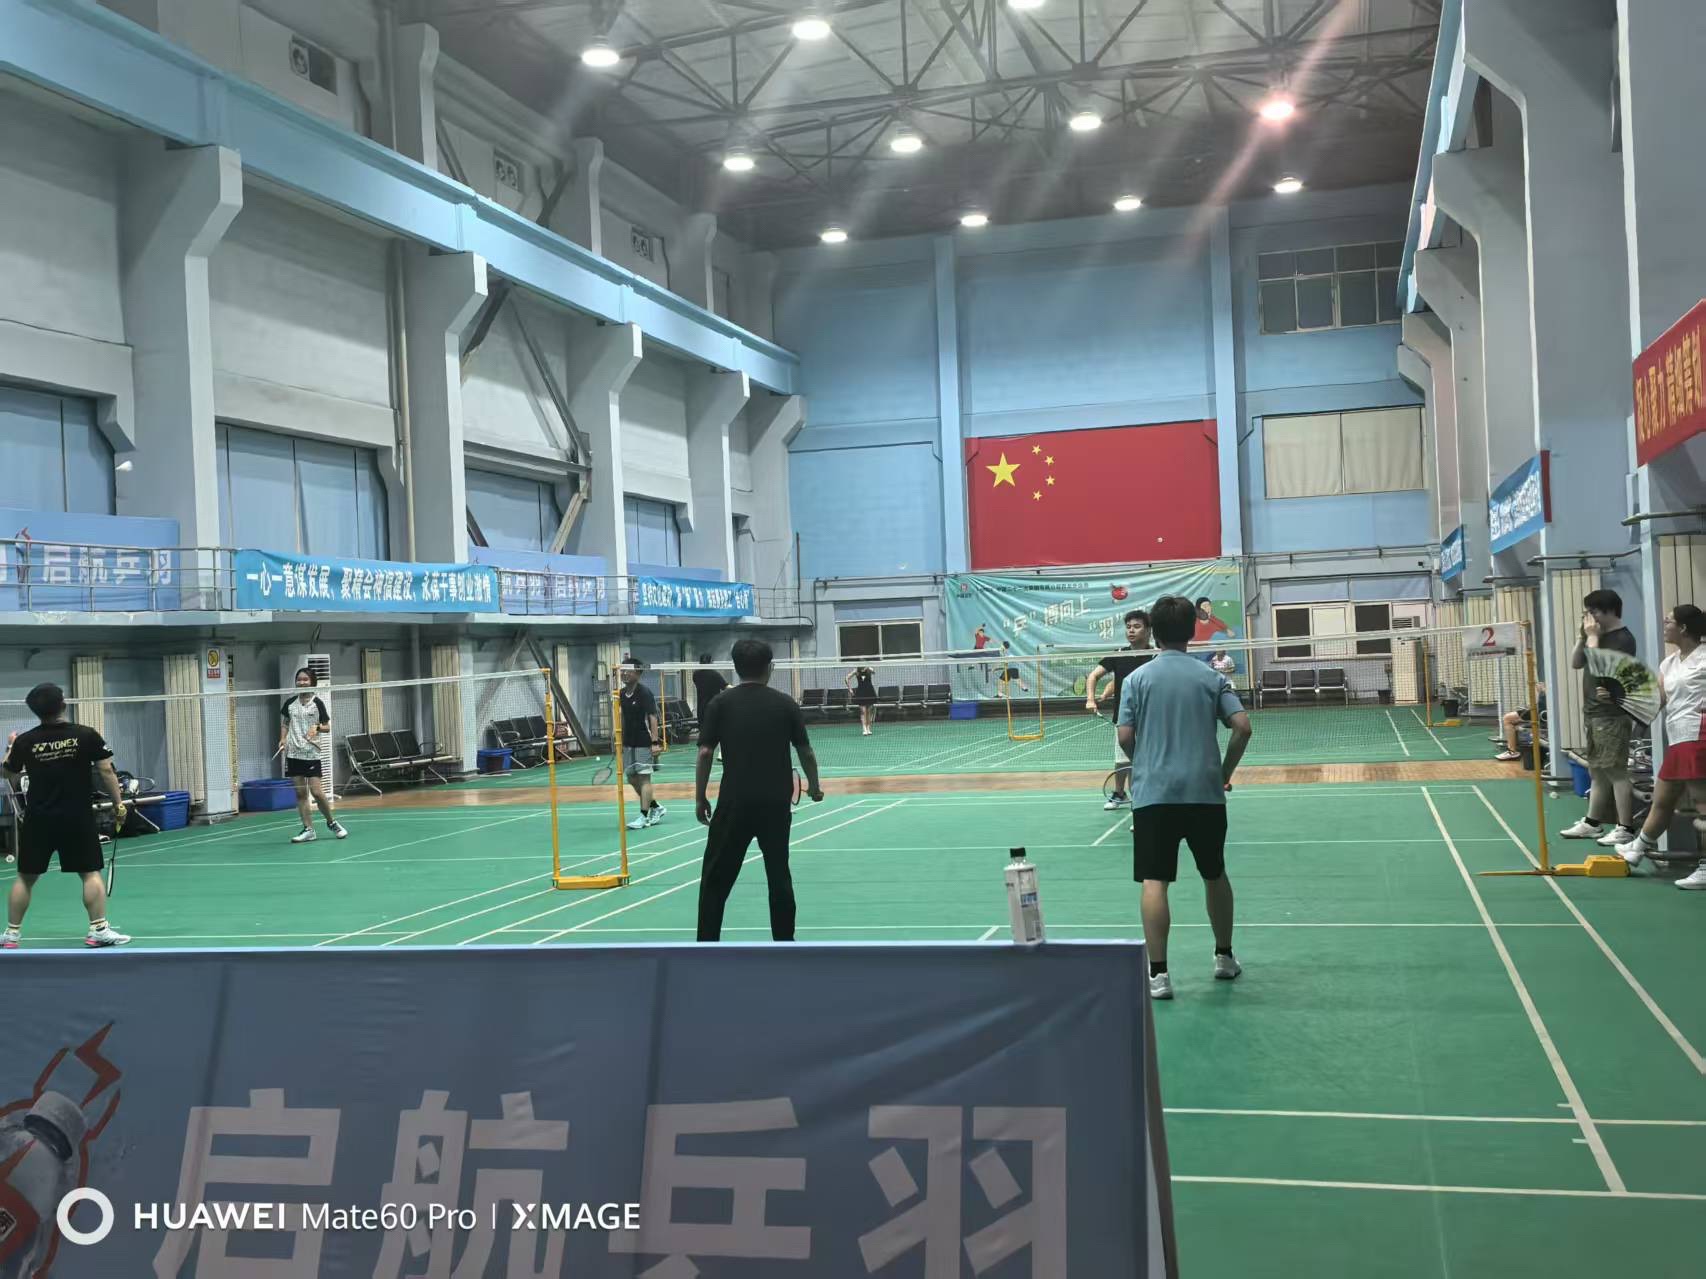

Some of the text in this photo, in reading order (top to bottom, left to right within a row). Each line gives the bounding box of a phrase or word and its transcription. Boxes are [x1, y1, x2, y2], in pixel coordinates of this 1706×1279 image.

[1481, 626, 1497, 647] 2
[49, 738, 79, 751] YONEX
[152, 1087, 1067, 1279] 启航乒羽
